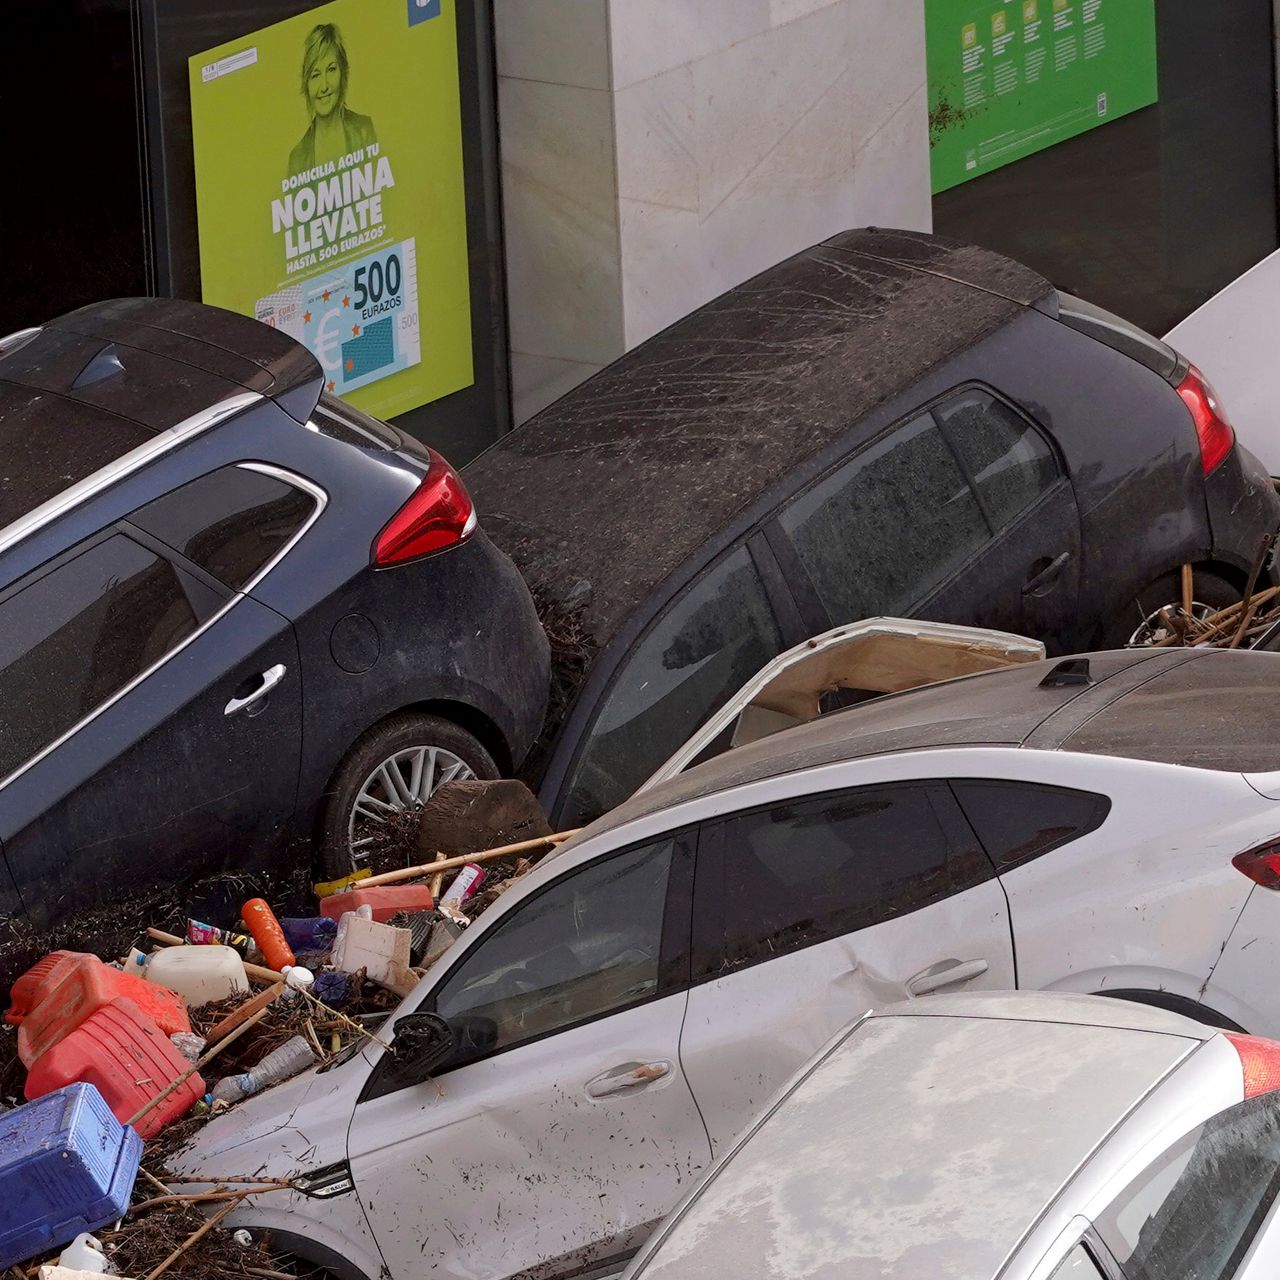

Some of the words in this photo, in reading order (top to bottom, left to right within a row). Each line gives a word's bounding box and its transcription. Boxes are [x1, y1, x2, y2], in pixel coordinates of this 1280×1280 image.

[282, 161, 335, 192] DOMICILIA
[338, 151, 365, 170] AQUI
[366, 142, 379, 158] TU
[271, 155, 395, 234] NOMINA
[284, 193, 383, 260] LLEVATE
[287, 252, 318, 275] HASTA
[319, 244, 338, 262] 500
[354, 254, 401, 310] 500
[362, 295, 402, 320] EURAZOS
[401, 312, 418, 330] 500
